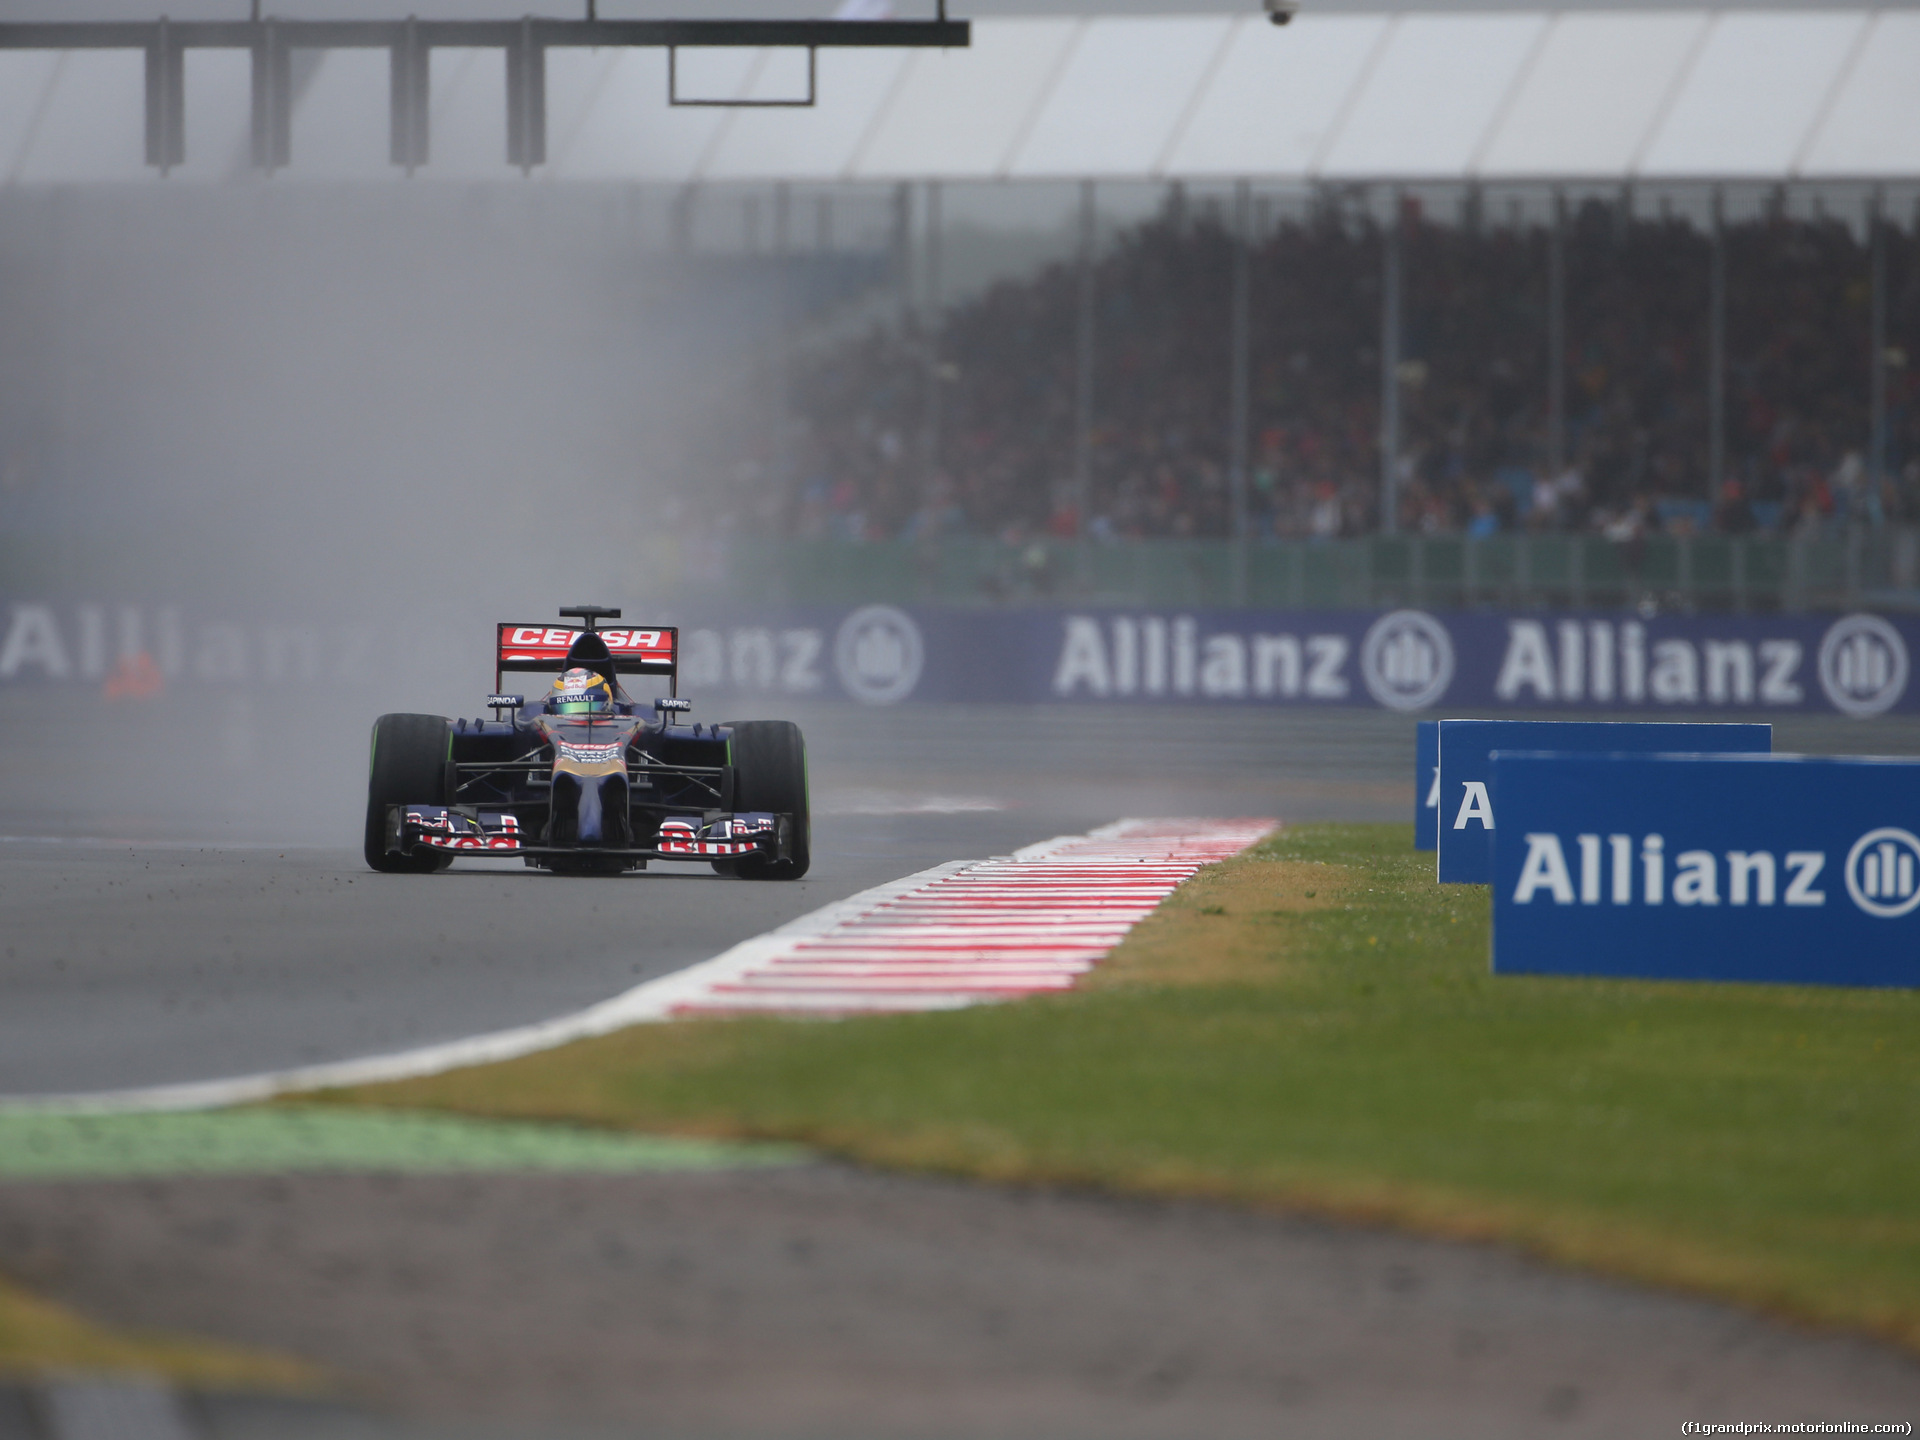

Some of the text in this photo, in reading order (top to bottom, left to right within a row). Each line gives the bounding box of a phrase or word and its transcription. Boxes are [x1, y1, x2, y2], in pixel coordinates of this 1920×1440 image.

[1053, 615, 1349, 697] Allianz
[1497, 619, 1803, 703] Allianz
[556, 694, 595, 704] RENAULT
[1513, 833, 1827, 906] Allianz
